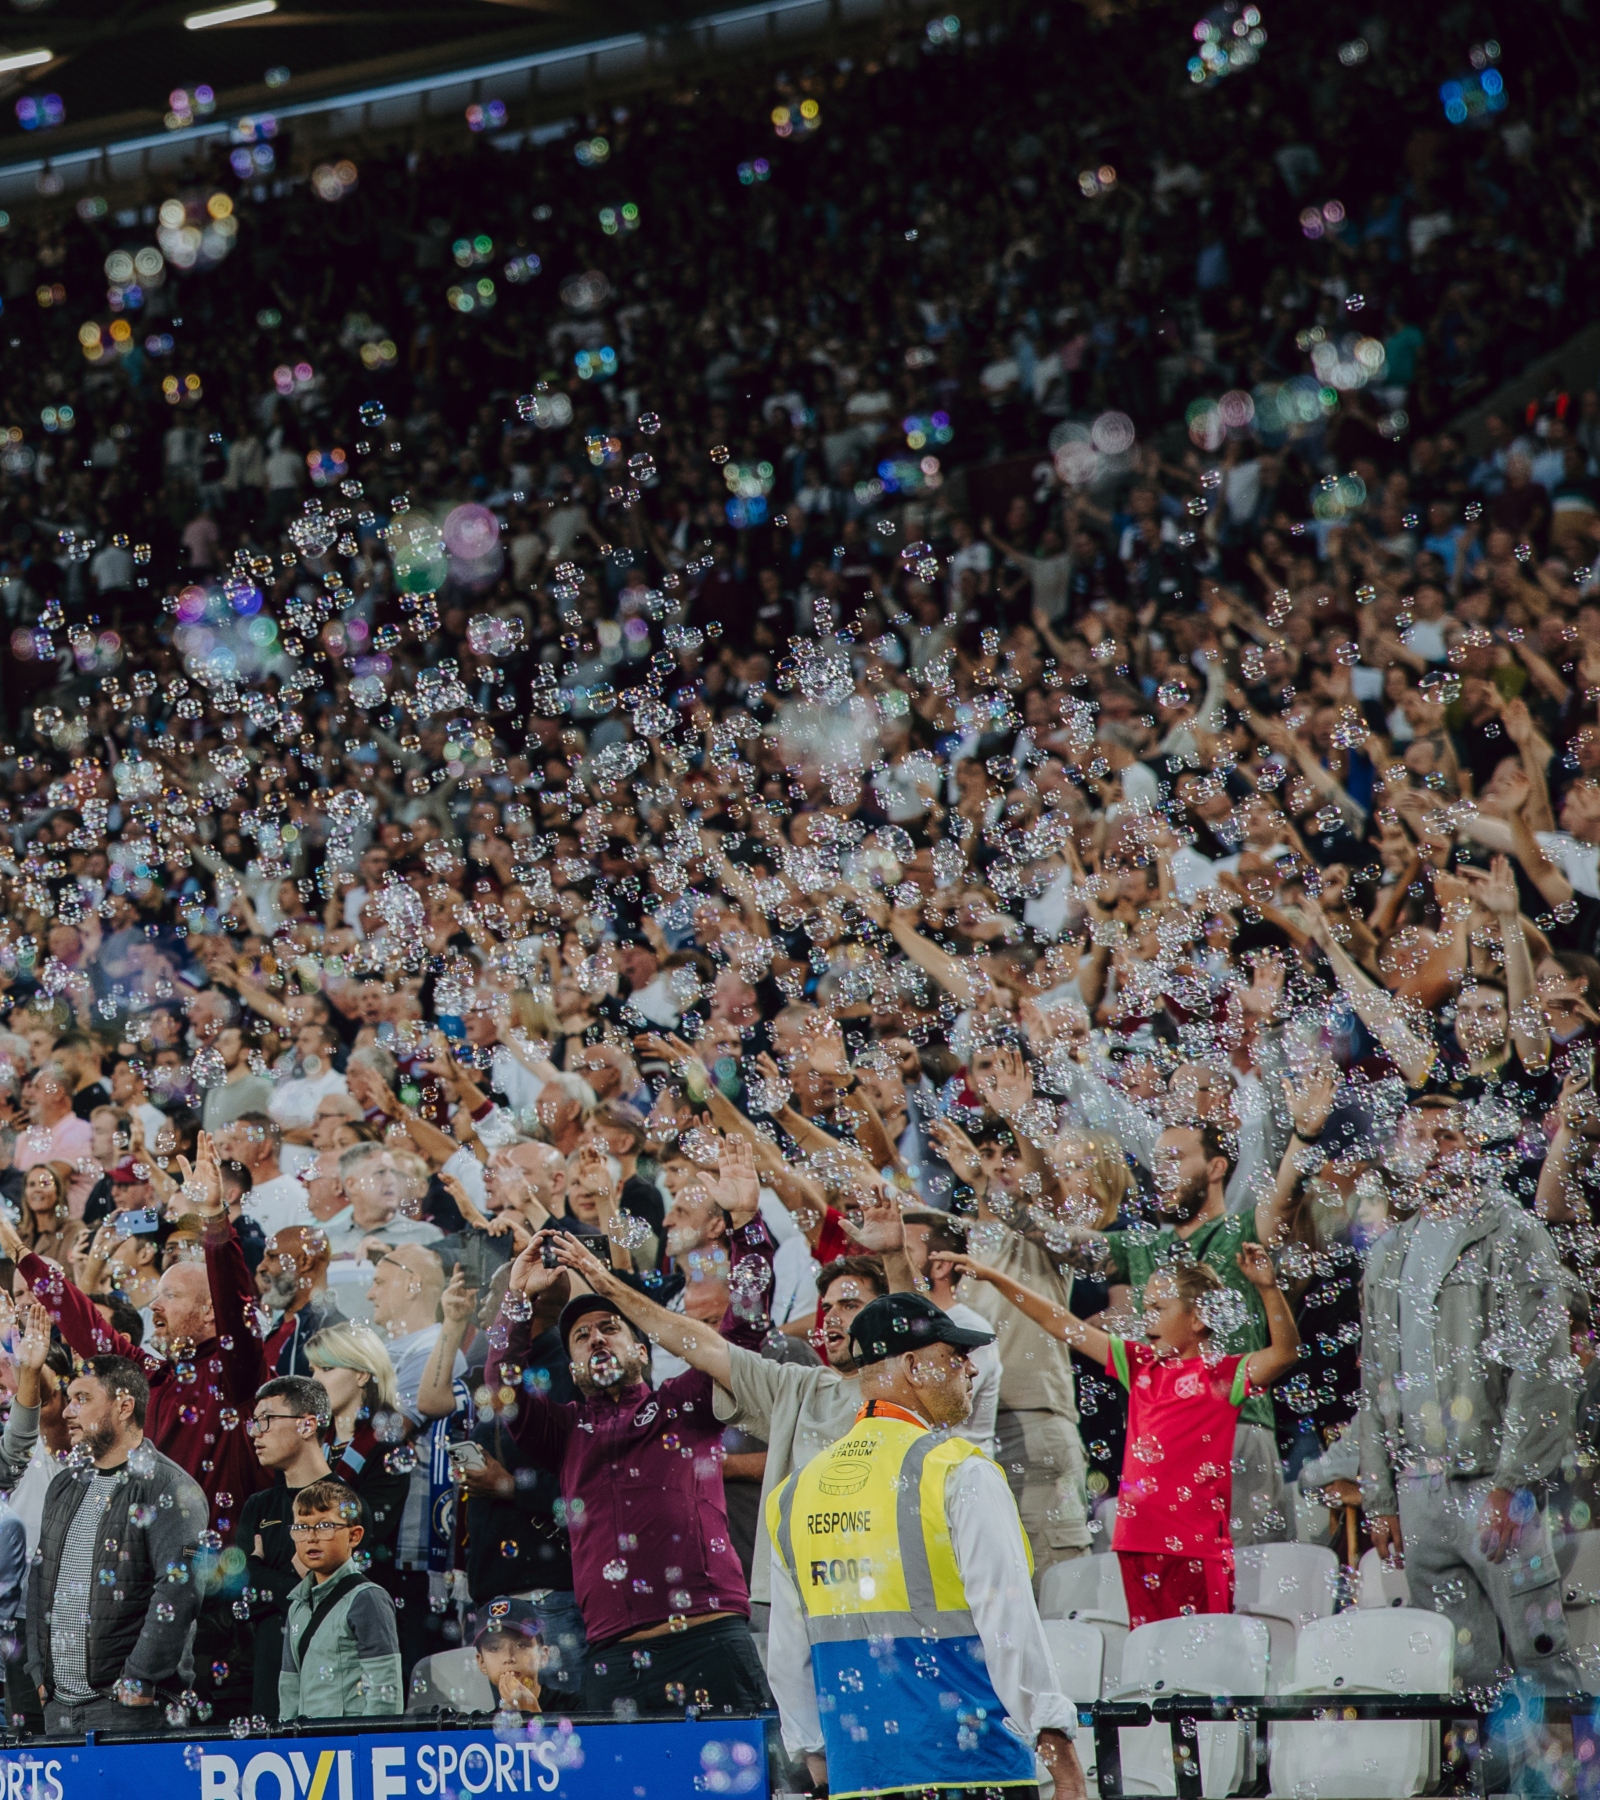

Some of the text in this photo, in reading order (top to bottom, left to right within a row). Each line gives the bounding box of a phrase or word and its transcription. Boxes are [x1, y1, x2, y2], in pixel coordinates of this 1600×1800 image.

[831, 1448, 873, 1459] STADIUM
[834, 1440, 877, 1453] LONDON
[807, 1510, 871, 1535] RESPONSE
[201, 1741, 560, 1800] BOYLE SPORTS
